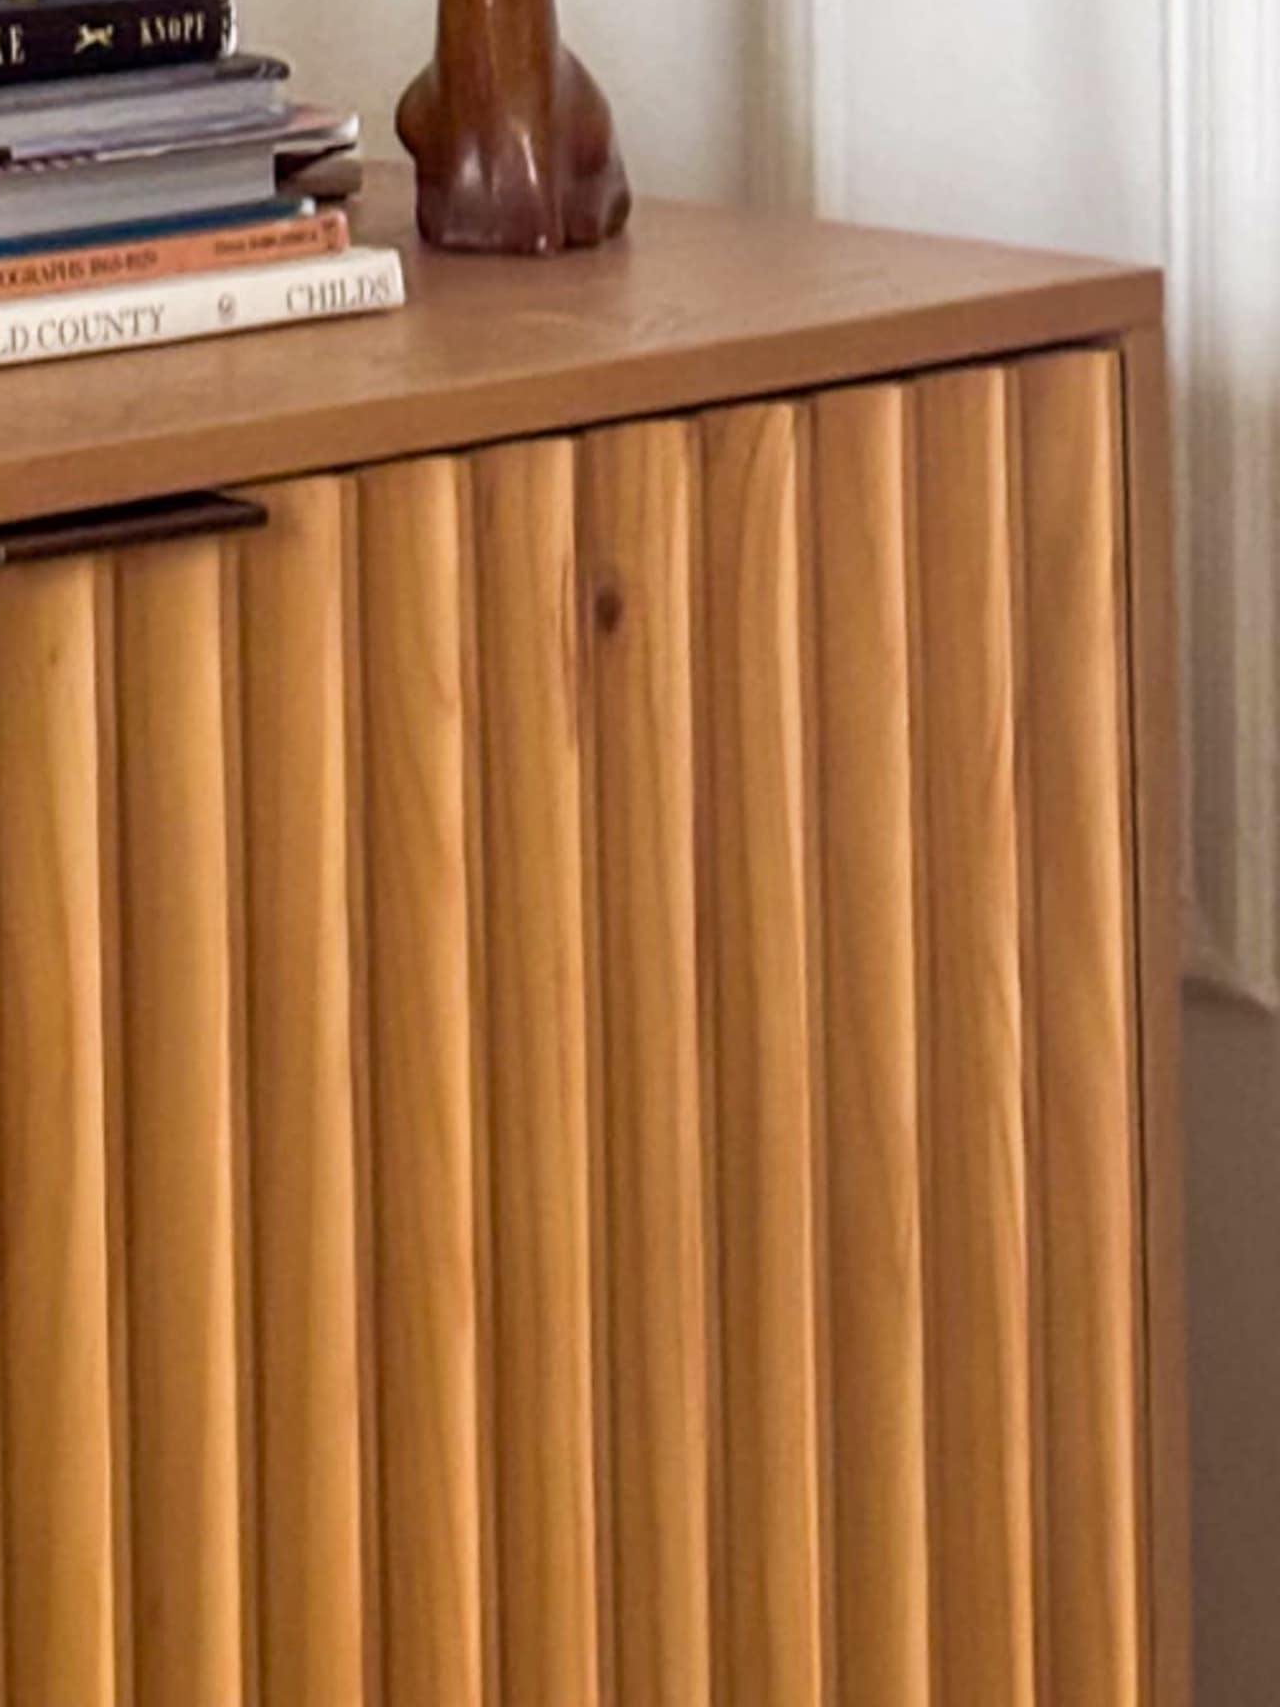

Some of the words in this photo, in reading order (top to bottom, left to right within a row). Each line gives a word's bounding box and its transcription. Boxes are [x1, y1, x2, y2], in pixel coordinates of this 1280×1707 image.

[140, 11, 207, 46] KNOPF
[286, 274, 392, 313] CHILDS
[37, 303, 166, 352] COUNTY
